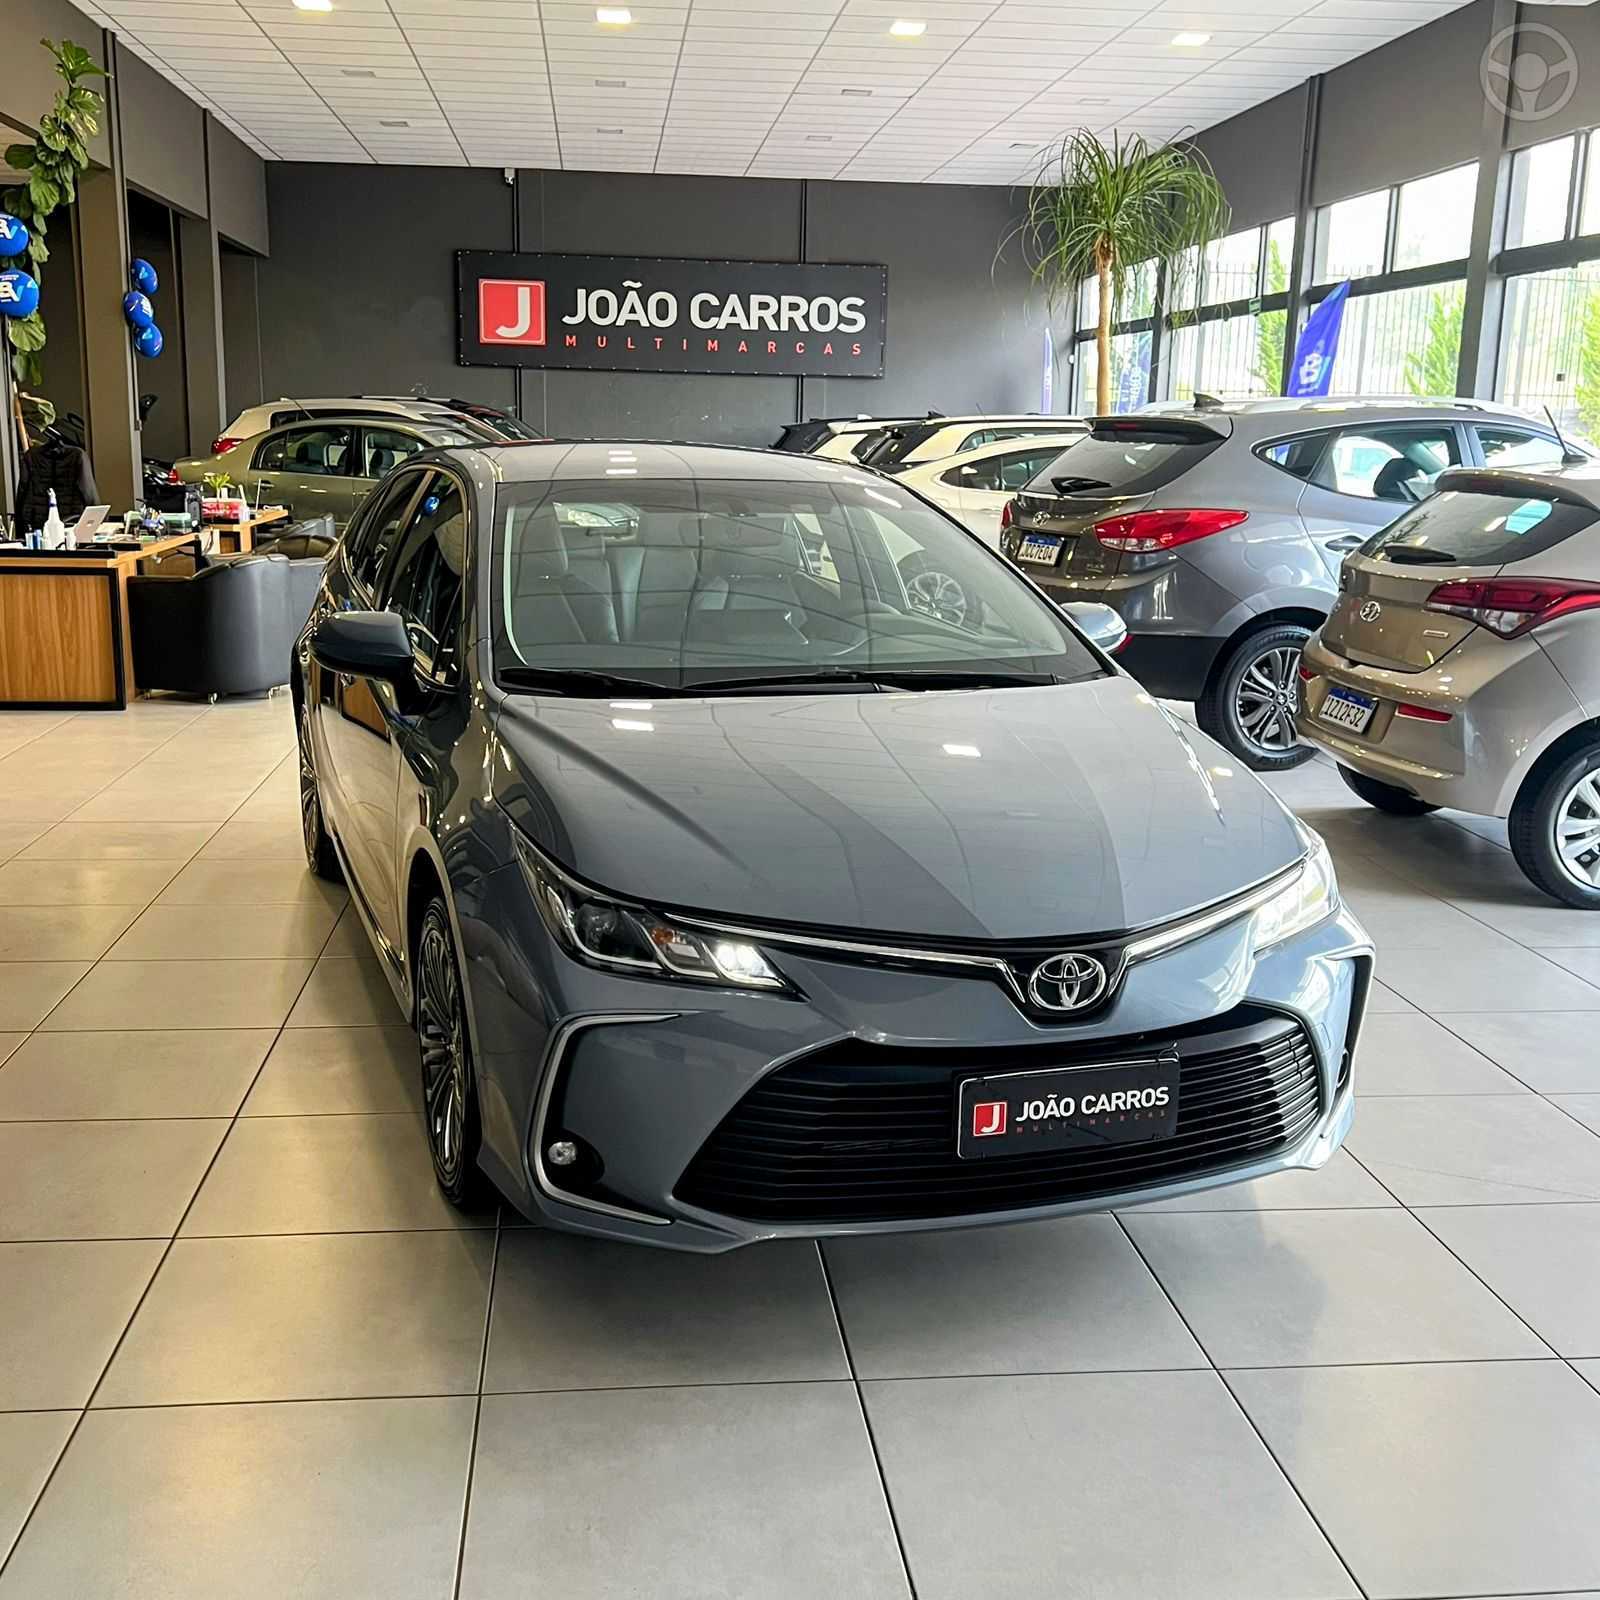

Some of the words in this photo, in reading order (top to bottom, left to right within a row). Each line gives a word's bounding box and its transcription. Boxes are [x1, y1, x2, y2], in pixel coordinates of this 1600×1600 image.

[495, 286, 531, 338] J
[562, 280, 678, 328] JOÃO
[690, 293, 867, 334] CARROS
[565, 335, 861, 355] MULTIMARCAS
[980, 1104, 1000, 1133] J
[1015, 1094, 1076, 1122] JOÃO
[1081, 1086, 1170, 1115] CARROS
